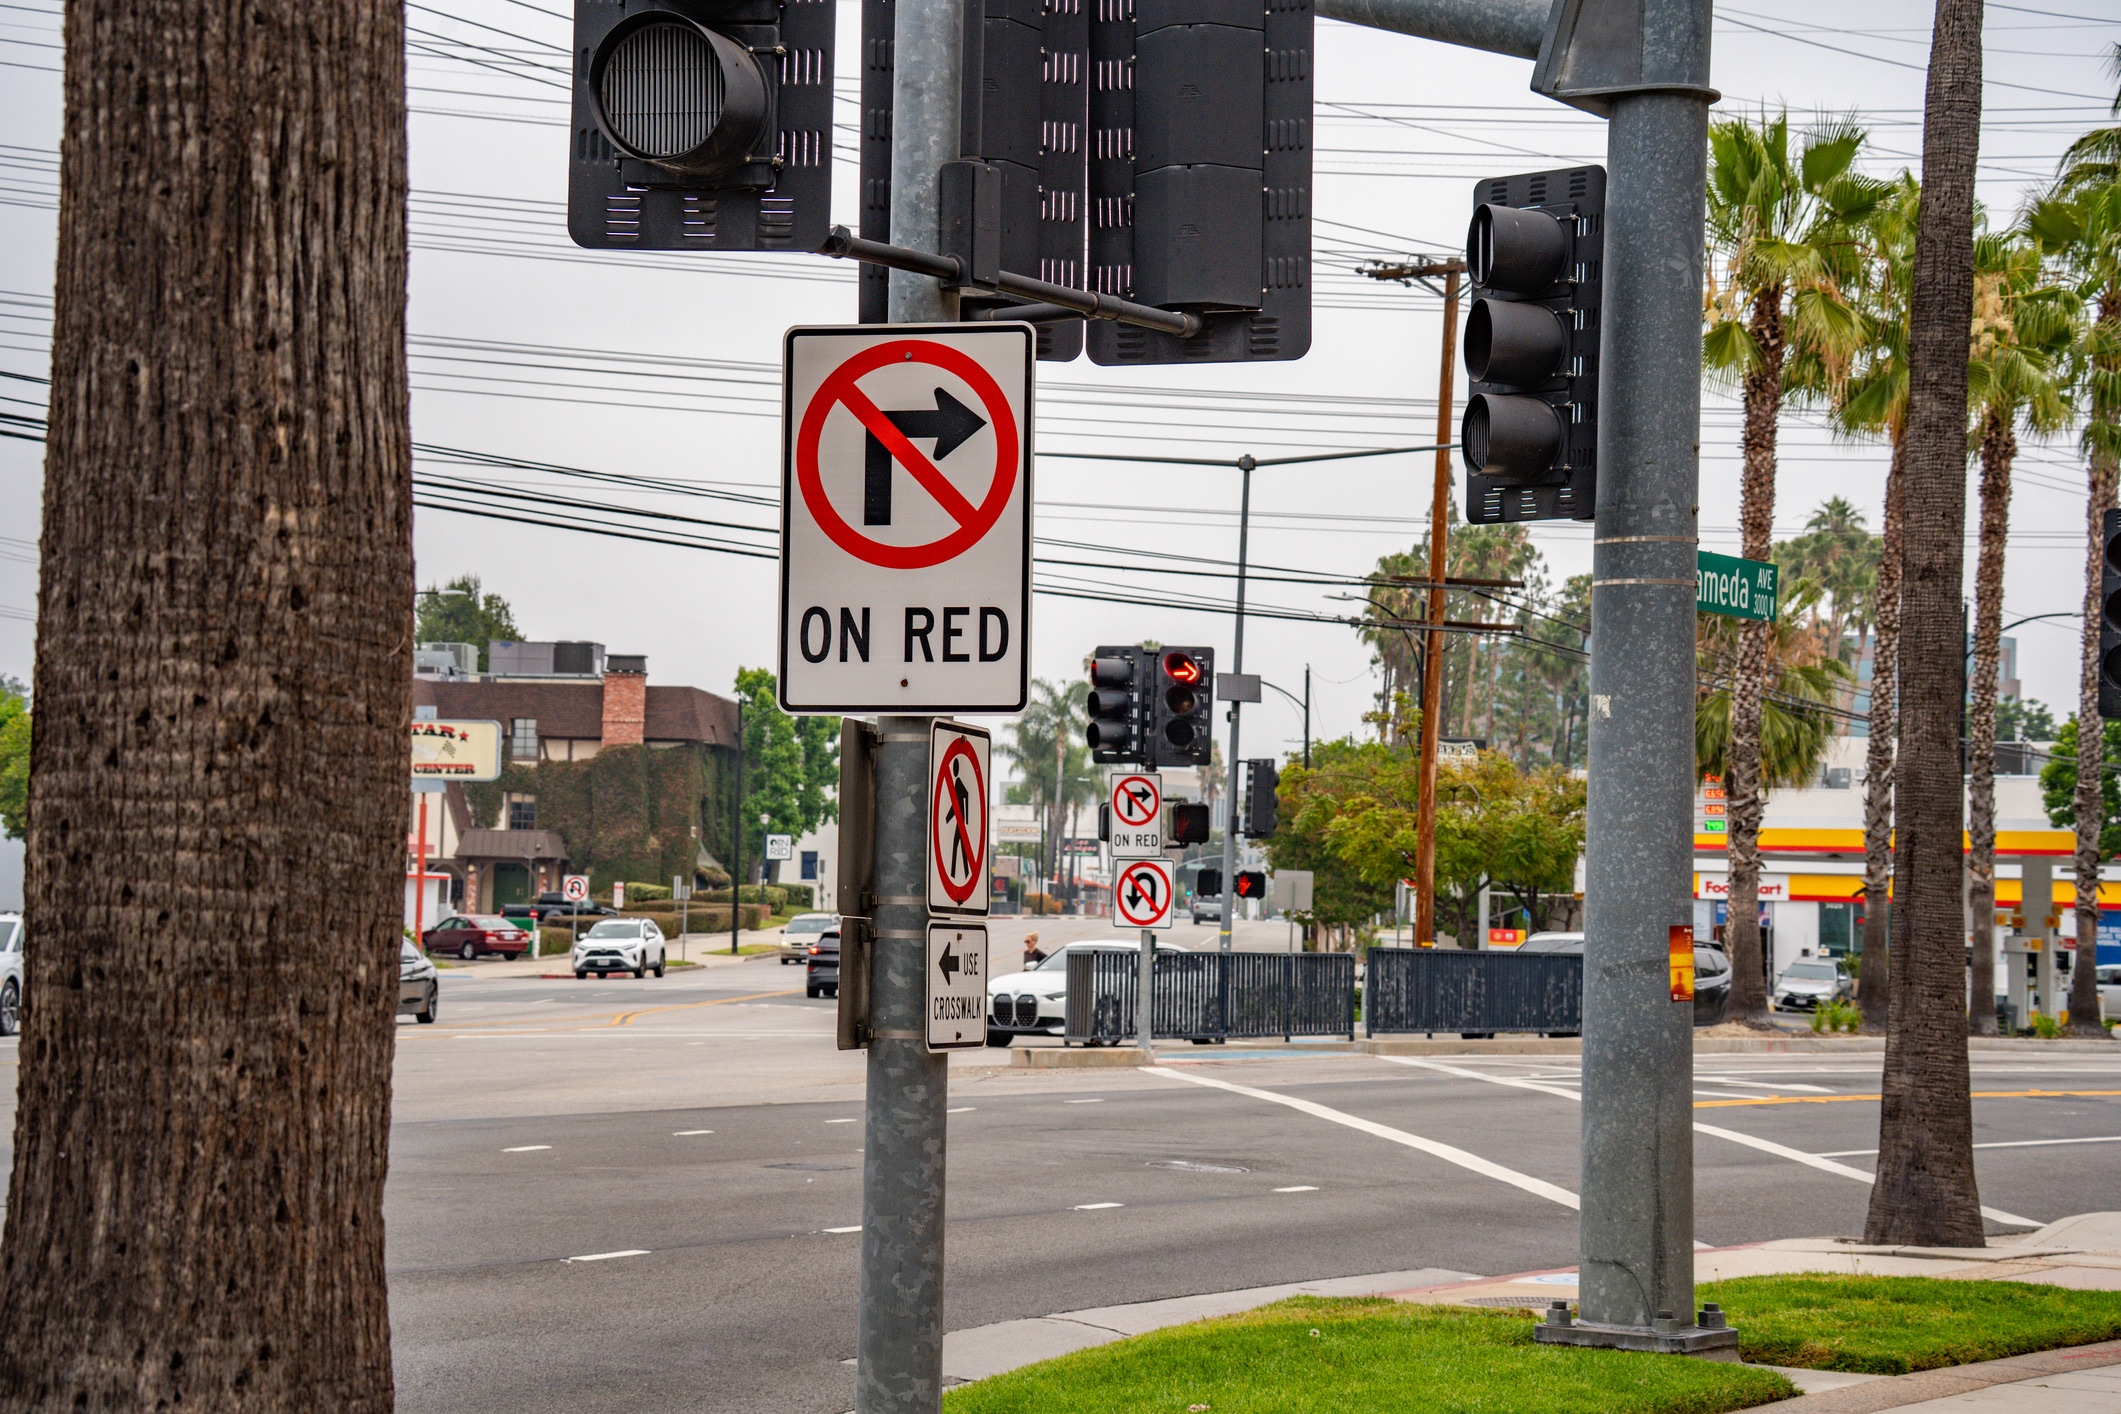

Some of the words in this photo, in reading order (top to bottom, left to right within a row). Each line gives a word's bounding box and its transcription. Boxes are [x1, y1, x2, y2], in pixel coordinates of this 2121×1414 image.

[1757, 568, 1774, 590] AVE
[1753, 593, 1769, 616] 3000
[800, 606, 870, 664] ON
[904, 606, 1010, 663] RED
[413, 763, 476, 775] CENTER
[1114, 833, 1130, 847] ON
[1135, 833, 1158, 847] RED
[963, 952, 979, 976] USE
[934, 996, 982, 1021] CROSSWALK
